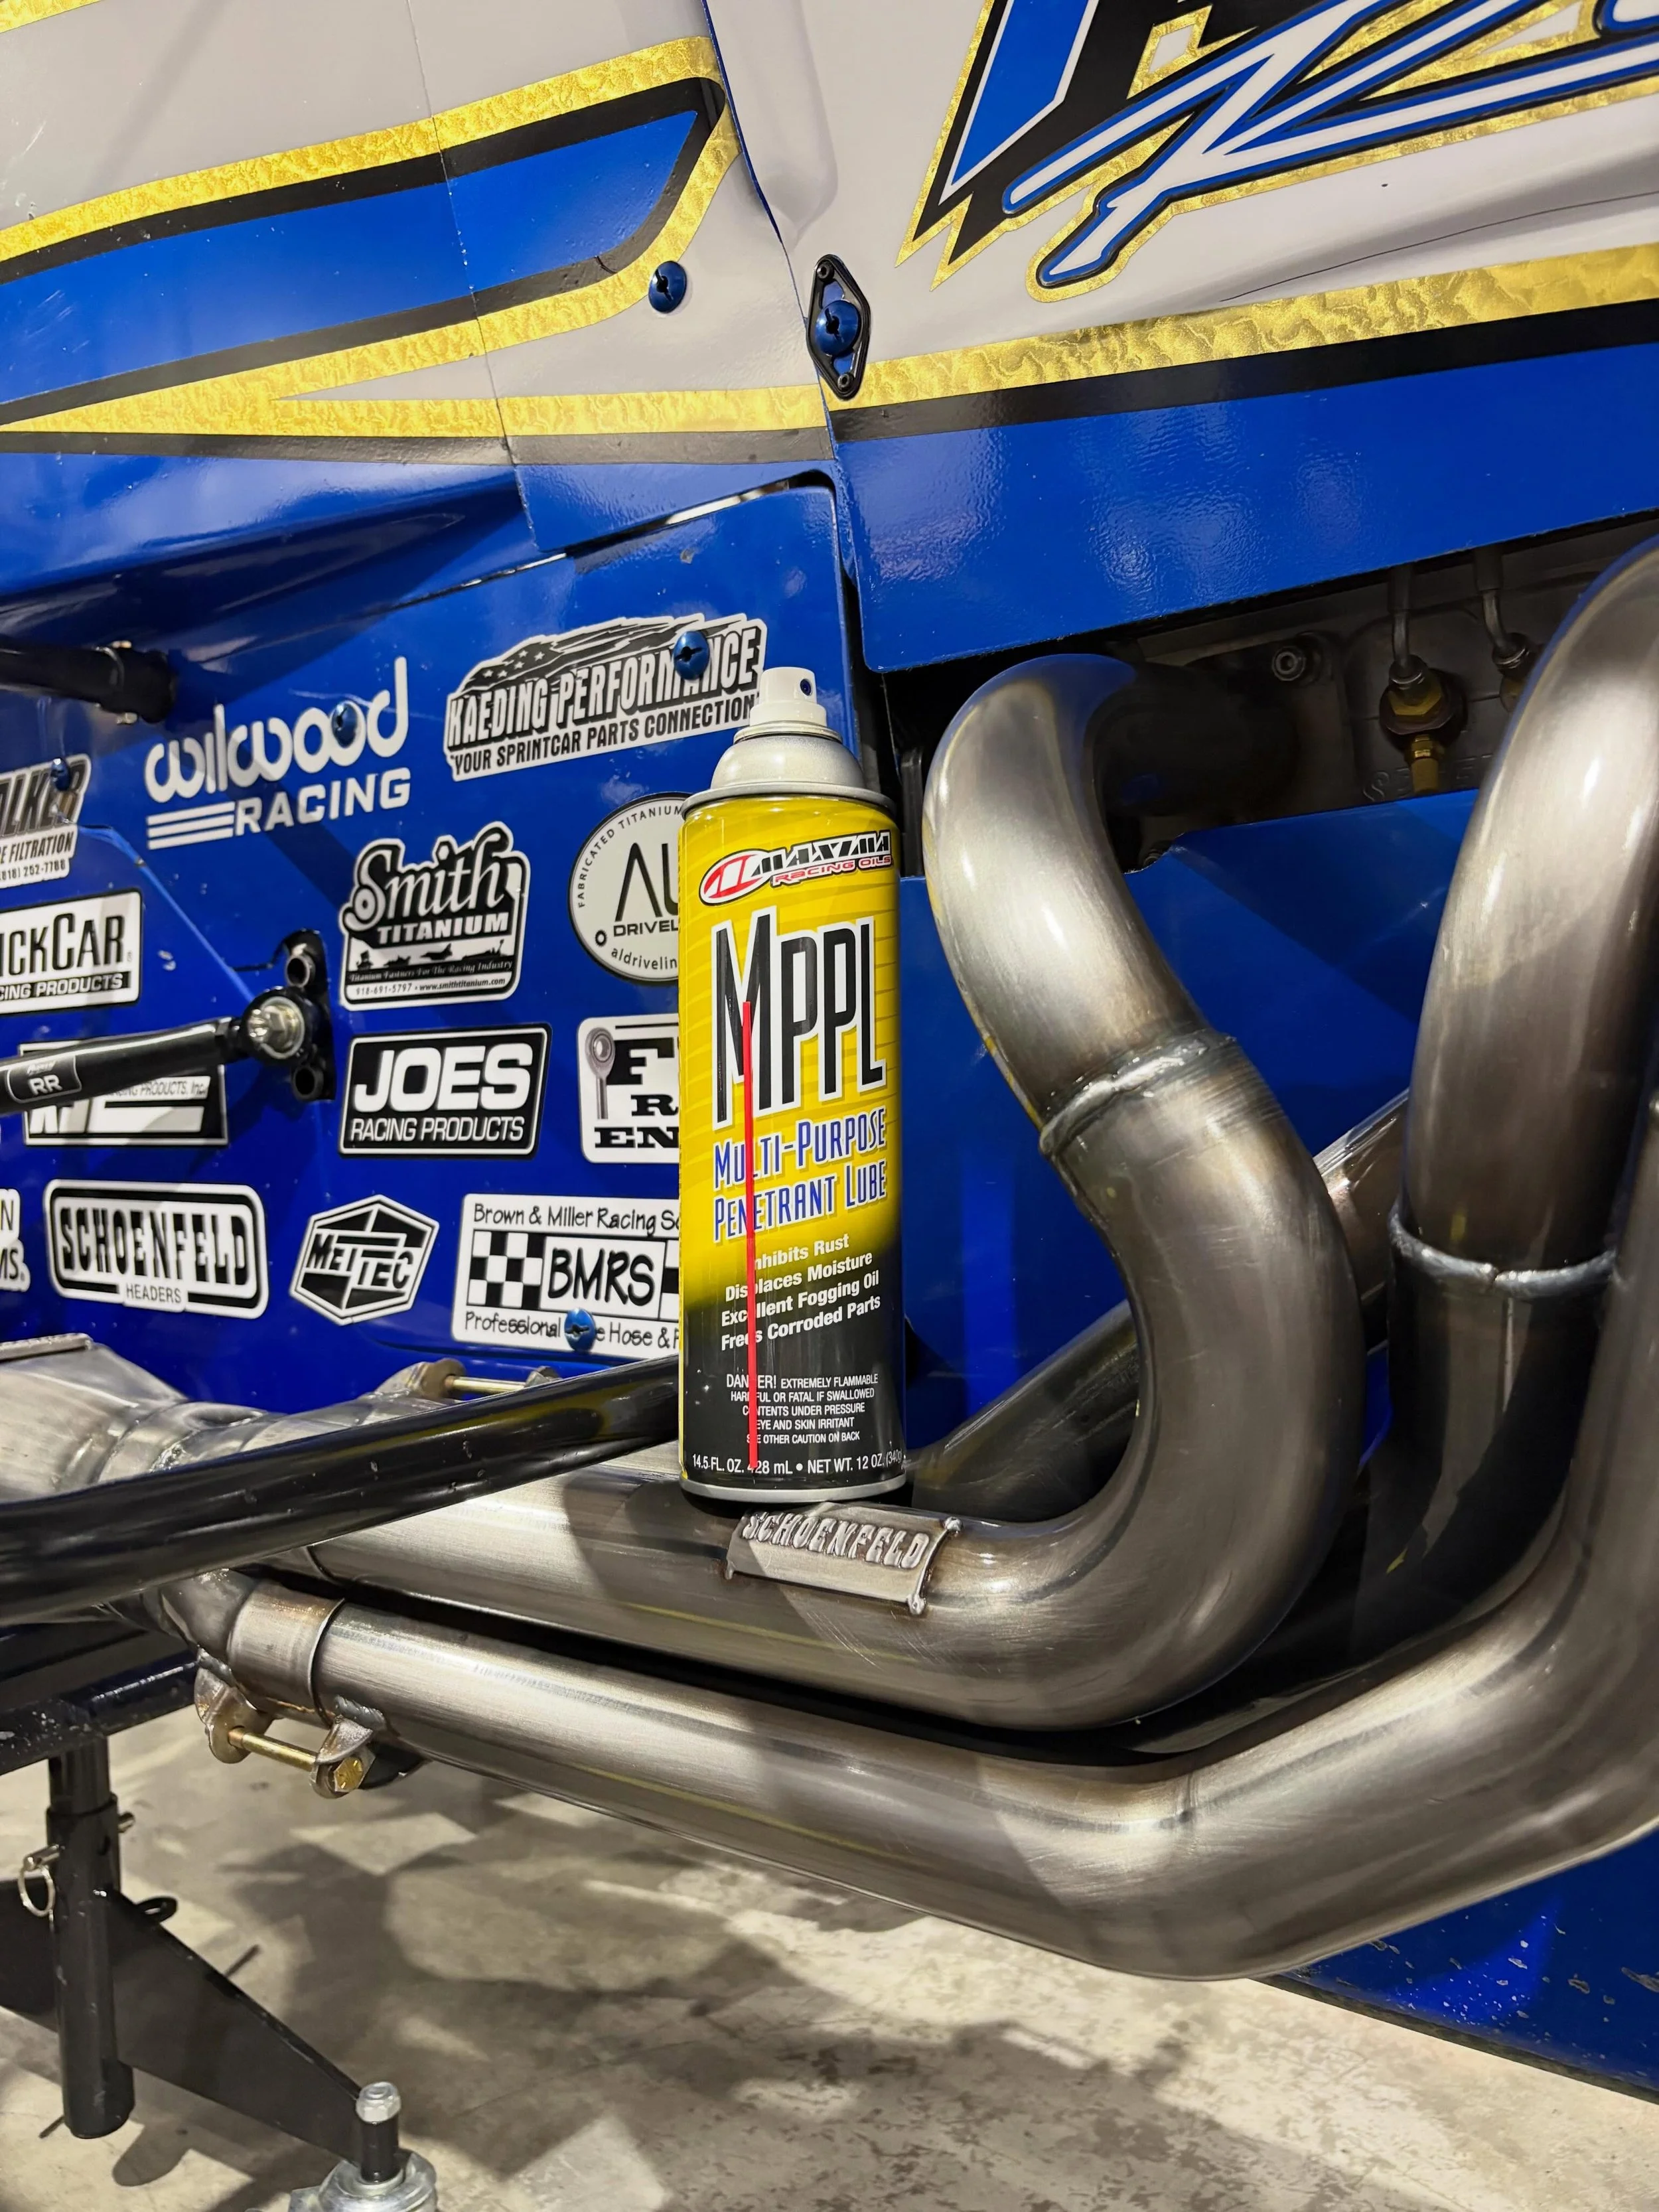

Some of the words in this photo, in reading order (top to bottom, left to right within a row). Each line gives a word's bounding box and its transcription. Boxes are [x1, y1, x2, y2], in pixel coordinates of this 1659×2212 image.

[446, 676, 549, 749] KAEDING
[145, 656, 408, 802] wilwood
[497, 731, 581, 767] SPRINTCAR
[587, 718, 639, 749] PARTS
[236, 767, 411, 836] RACING
[9, 832, 74, 863] FILTRATION
[578, 828, 615, 908] FABRICATED
[618, 805, 682, 830] TITANIUM
[751, 832, 890, 877] MAXIMA
[860, 855, 891, 867] OILS
[343, 833, 505, 931] Smith
[378, 913, 510, 944] TITANIUM
[478, 960, 512, 971] Industry
[36, 973, 123, 997] PRODUCTS
[356, 982, 412, 995] 918-691-5797
[419, 978, 505, 992] www.smithtitanium.com
[714, 912, 885, 1125] MPPL
[29, 1074, 62, 1096] RR
[354, 1043, 533, 1112] JOES
[351, 1118, 417, 1142] RACING
[421, 1116, 525, 1142] PRODUCTS
[715, 1108, 885, 1189] MUTI-PURPOSE
[715, 1175, 835, 1240] PENETRANT
[846, 1161, 885, 1207] LUBE
[474, 1203, 524, 1224] Brown
[529, 1205, 542, 1224] &
[547, 1205, 593, 1228] Miller
[597, 1207, 656, 1237] Racing
[60, 1207, 248, 1286] SCHOENFELD
[755, 1246, 809, 1270] nhibits
[814, 1233, 849, 1256] Rust
[548, 1247, 654, 1306] BMRS
[807, 1252, 873, 1282] Moisture
[127, 1283, 182, 1303] HEADERS
[721, 1296, 794, 1327] Excllent
[798, 1280, 860, 1309] Fogging
[863, 1270, 879, 1289] Oil
[465, 1311, 561, 1338] Professional
[767, 1306, 843, 1340] Corroded
[847, 1295, 881, 1319] Parts
[609, 1321, 653, 1347] Hose
[658, 1327, 670, 1349] &
[727, 1373, 776, 1388] DANER!
[780, 1377, 831, 1388] EXTREMELY
[833, 1374, 878, 1387] FLAMMABLE
[731, 1392, 771, 1402] HARFUL
[774, 1392, 786, 1402] OR
[789, 1391, 814, 1402] FATAL
[817, 1391, 824, 1402] IF
[827, 1388, 875, 1402] SWALLOWED
[742, 1405, 788, 1416] CNTENTS
[792, 1404, 822, 1416] UNDER
[824, 1402, 865, 1415] PRESSURE
[772, 1419, 792, 1430] AND
[794, 1418, 815, 1430] SKIN
[818, 1417, 855, 1429] IRRITANT
[747, 1434, 761, 1444] SE
[763, 1434, 790, 1444] OTHER
[792, 1433, 826, 1444] CAUTION
[828, 1432, 839, 1443] ON
[841, 1431, 860, 1441] BACK
[711, 1457, 725, 1471] FL.
[727, 1457, 744, 1473] OZ.
[774, 1460, 793, 1474] mL
[808, 1459, 831, 1474] NET
[833, 1457, 853, 1473] WT.
[856, 1456, 868, 1469] 12
[871, 1453, 885, 1468] OZ.
[742, 1511, 930, 1570] SCHOENFELD
